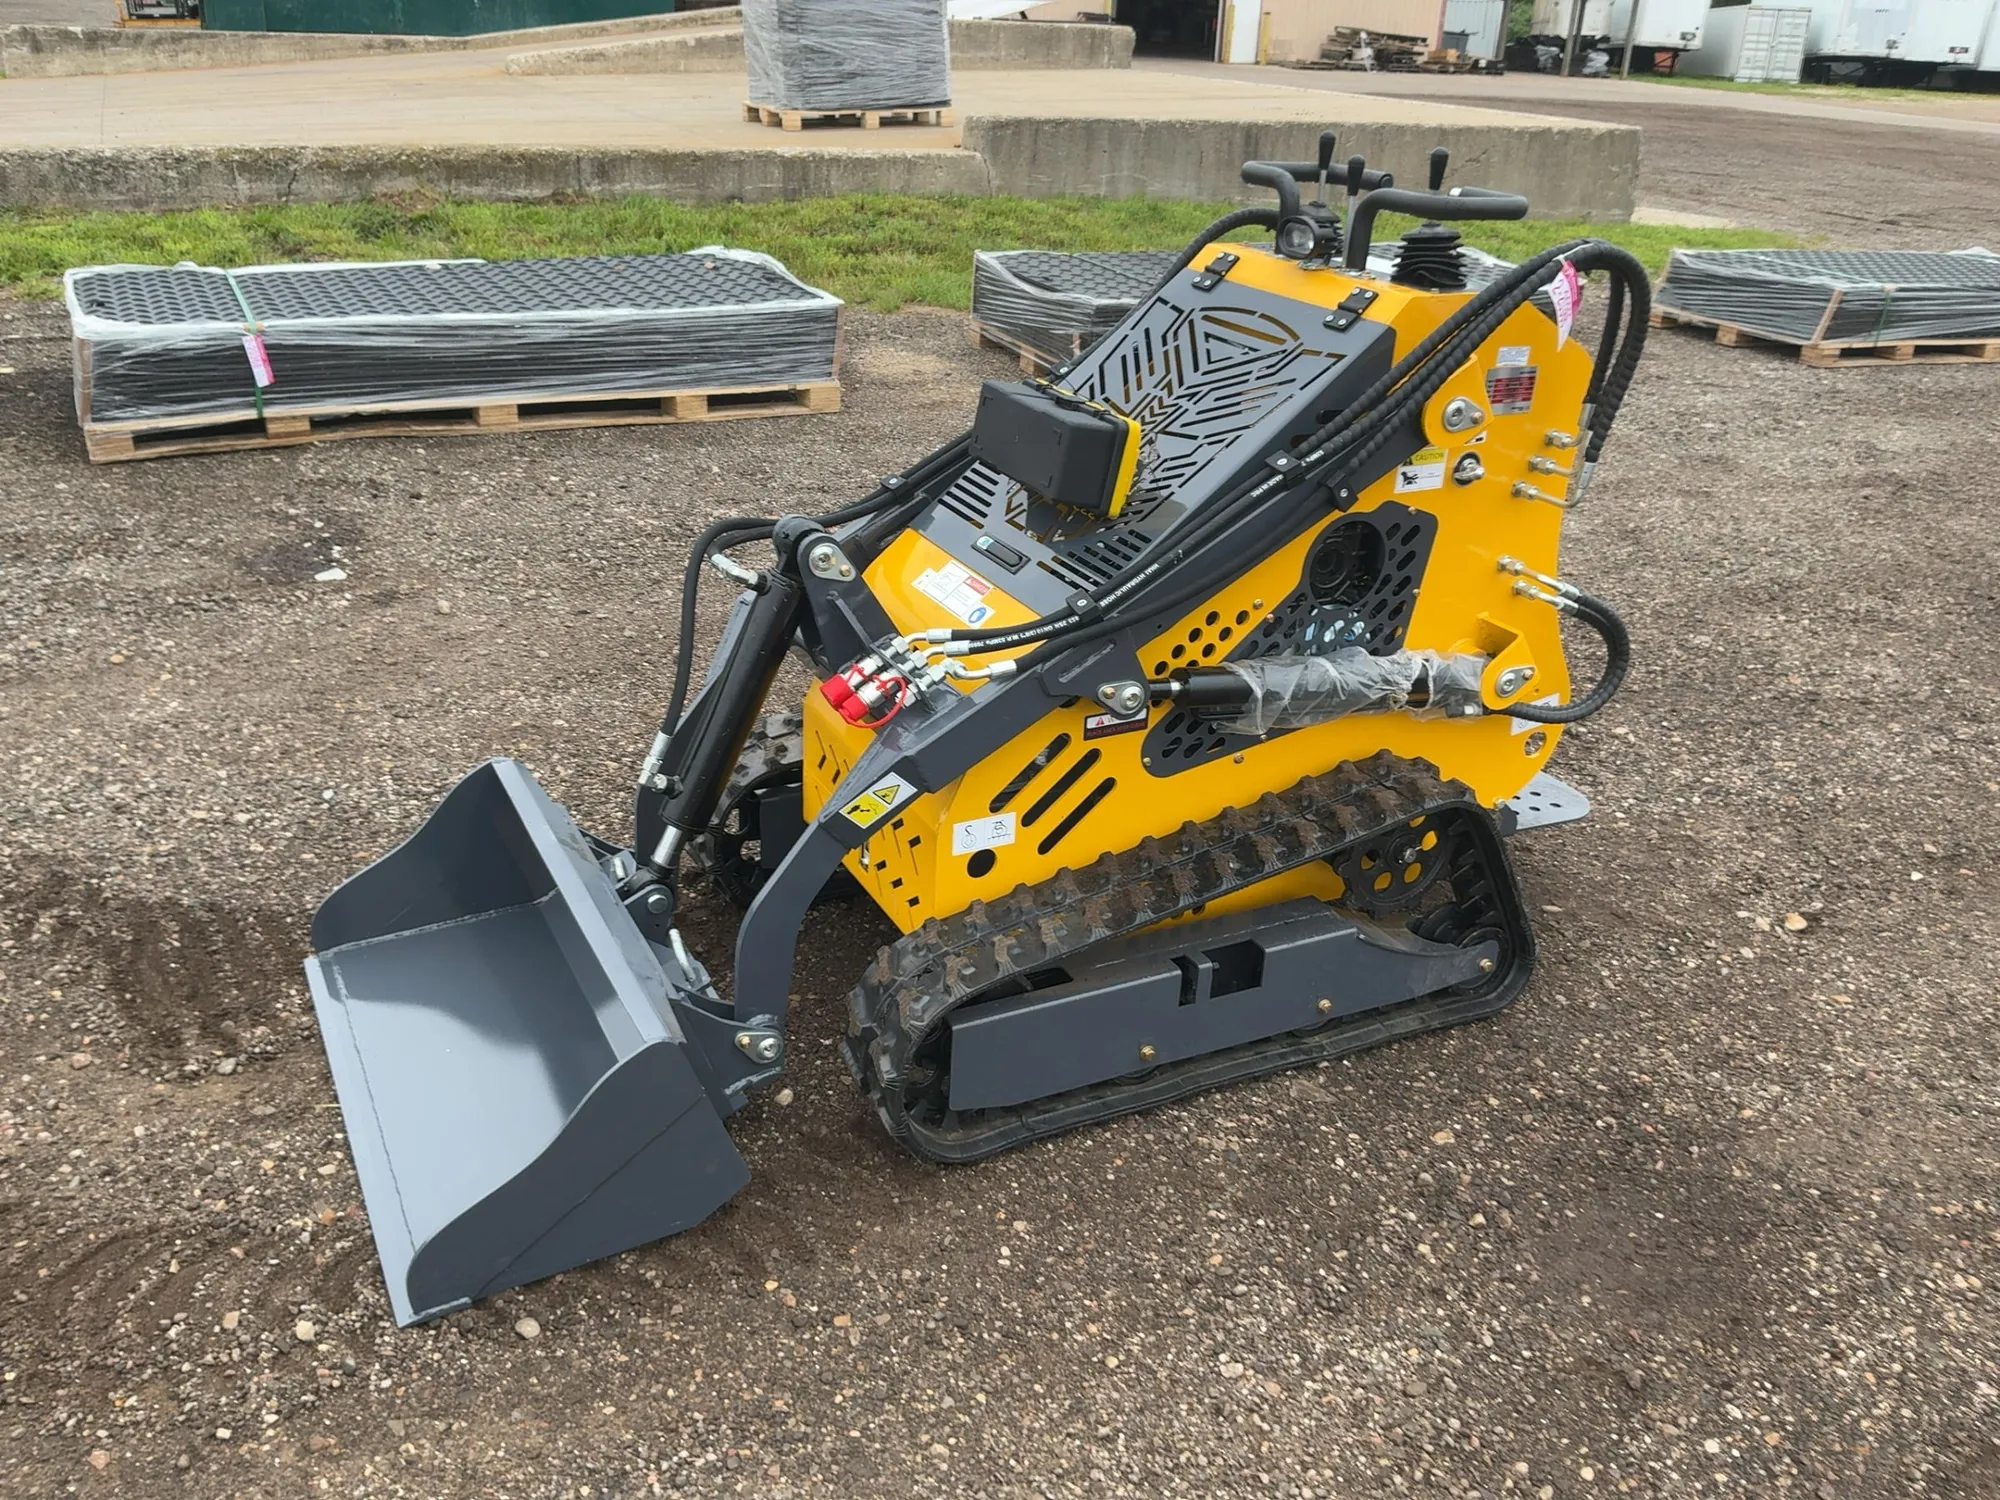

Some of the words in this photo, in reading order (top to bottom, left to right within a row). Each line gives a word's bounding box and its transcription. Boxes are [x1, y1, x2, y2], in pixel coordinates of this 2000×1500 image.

[1415, 452, 1444, 462] CAUTION
[1114, 572, 1146, 597] HYDRAULIC
[1099, 594, 1117, 608] HOSE
